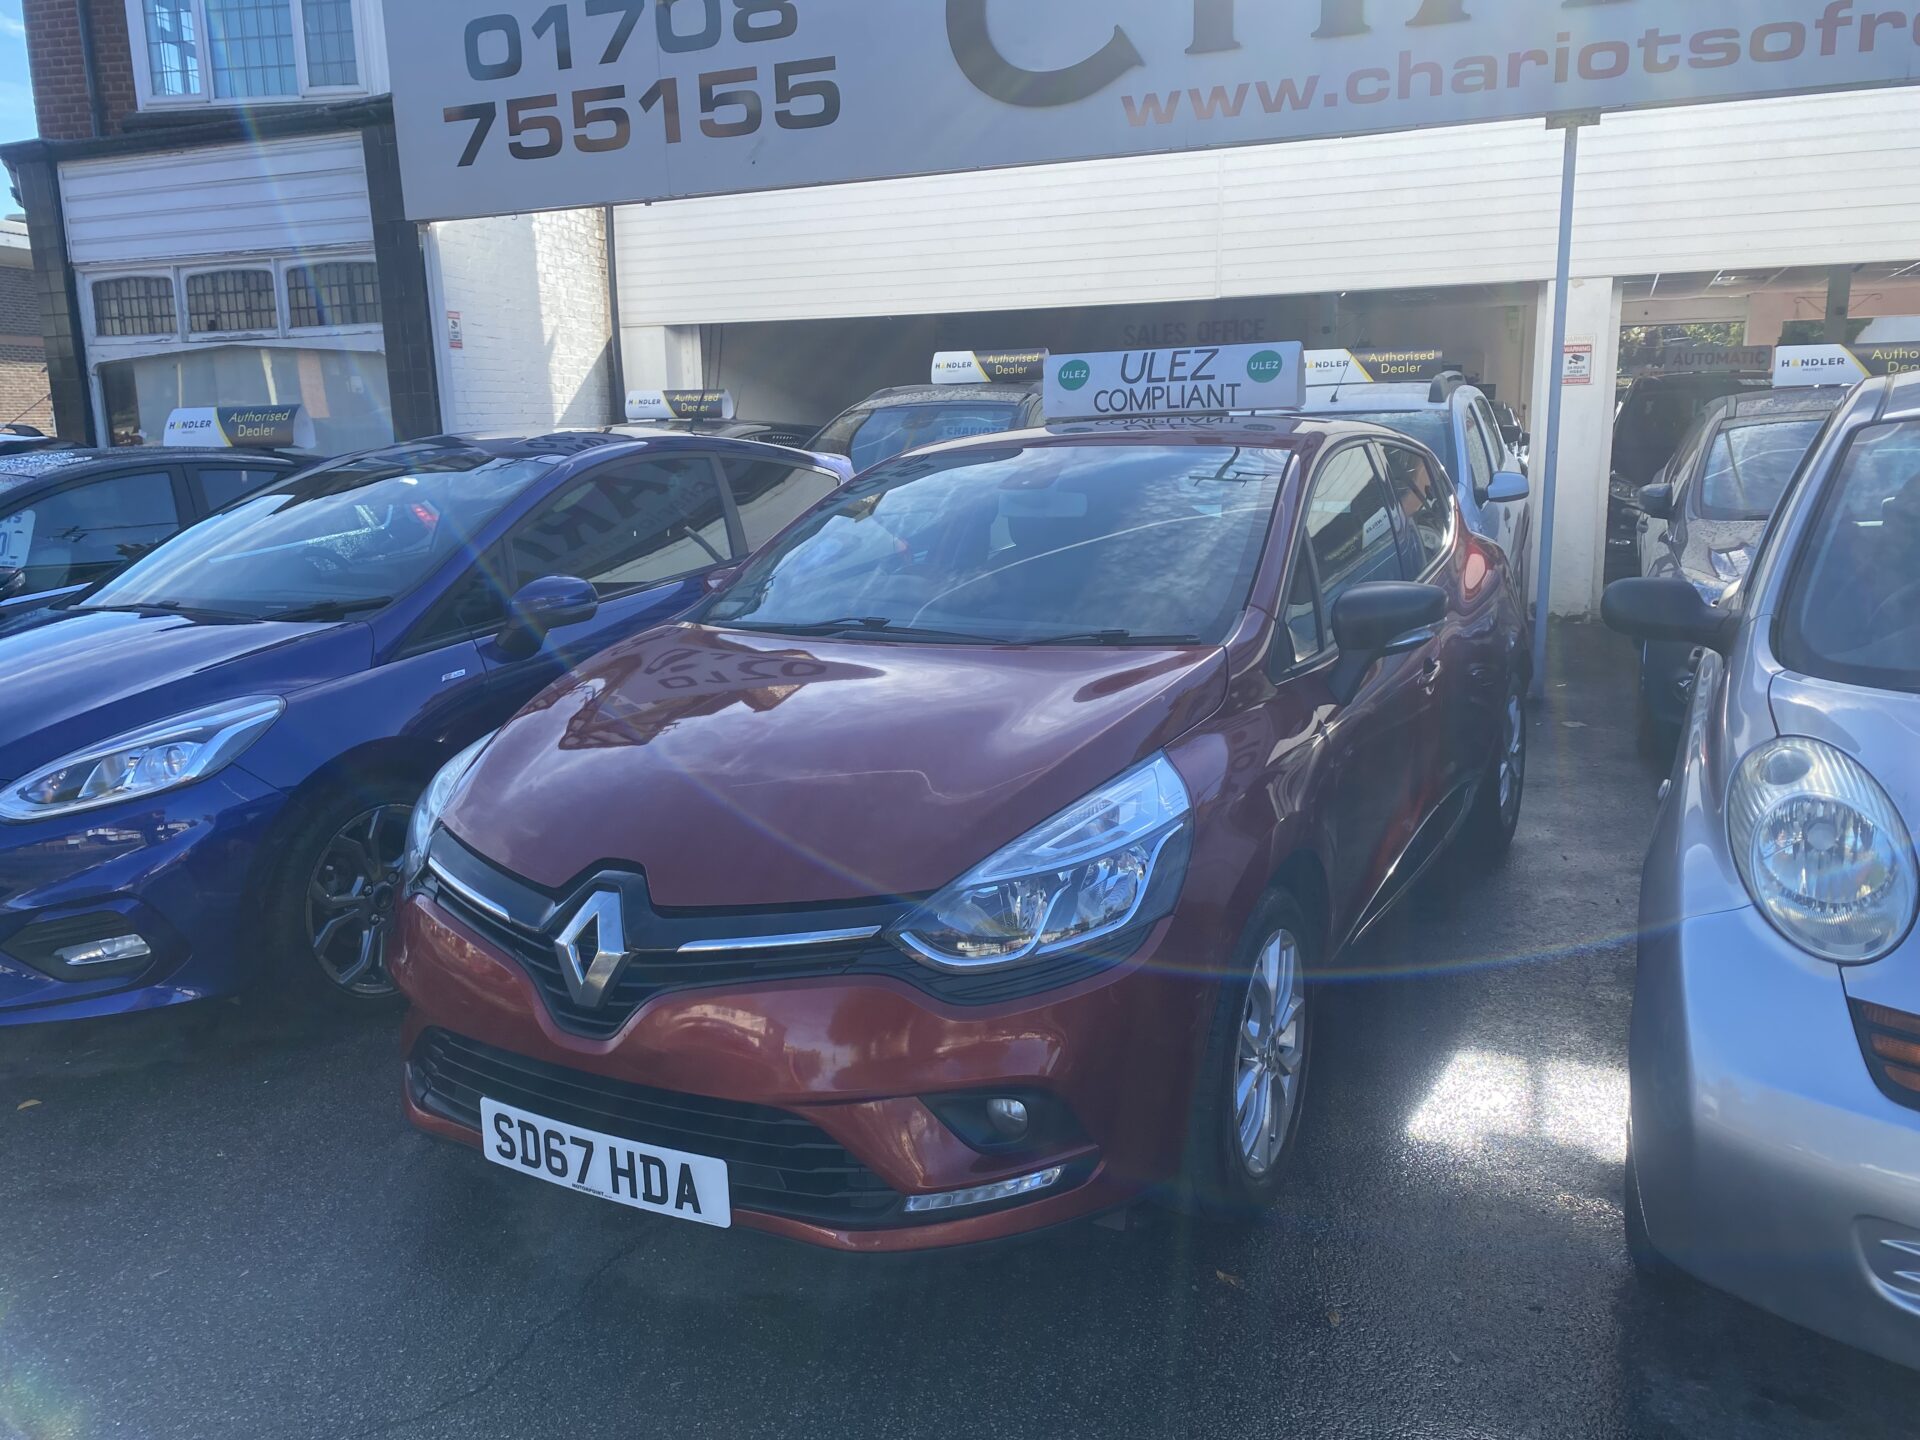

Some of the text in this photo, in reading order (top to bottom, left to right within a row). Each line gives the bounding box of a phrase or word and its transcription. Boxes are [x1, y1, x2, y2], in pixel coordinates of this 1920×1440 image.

[464, 0, 799, 81] 01708
[1120, 0, 1920, 128] www.chariotsofr
[443, 56, 841, 168] 755155
[1123, 319, 1265, 345] SALES OFFICE
[987, 353, 1040, 364] Authorised
[1368, 350, 1435, 362] Authorised
[1672, 350, 1767, 367] AUTOMATIC
[995, 364, 1027, 375] Dealer
[1120, 348, 1219, 384] ULEZ
[1250, 360, 1279, 370] ULEZ
[1381, 362, 1422, 374] Dealer
[1061, 369, 1087, 379] ULEZ
[673, 393, 720, 402] Authorsed
[1094, 383, 1241, 413] COMPLIANT
[681, 403, 709, 412] Deaer
[228, 409, 291, 423] Authorised
[238, 424, 275, 437] Dealer
[493, 1112, 702, 1215] SD67 HDA
[572, 1182, 604, 1196] MOTORPOINT
